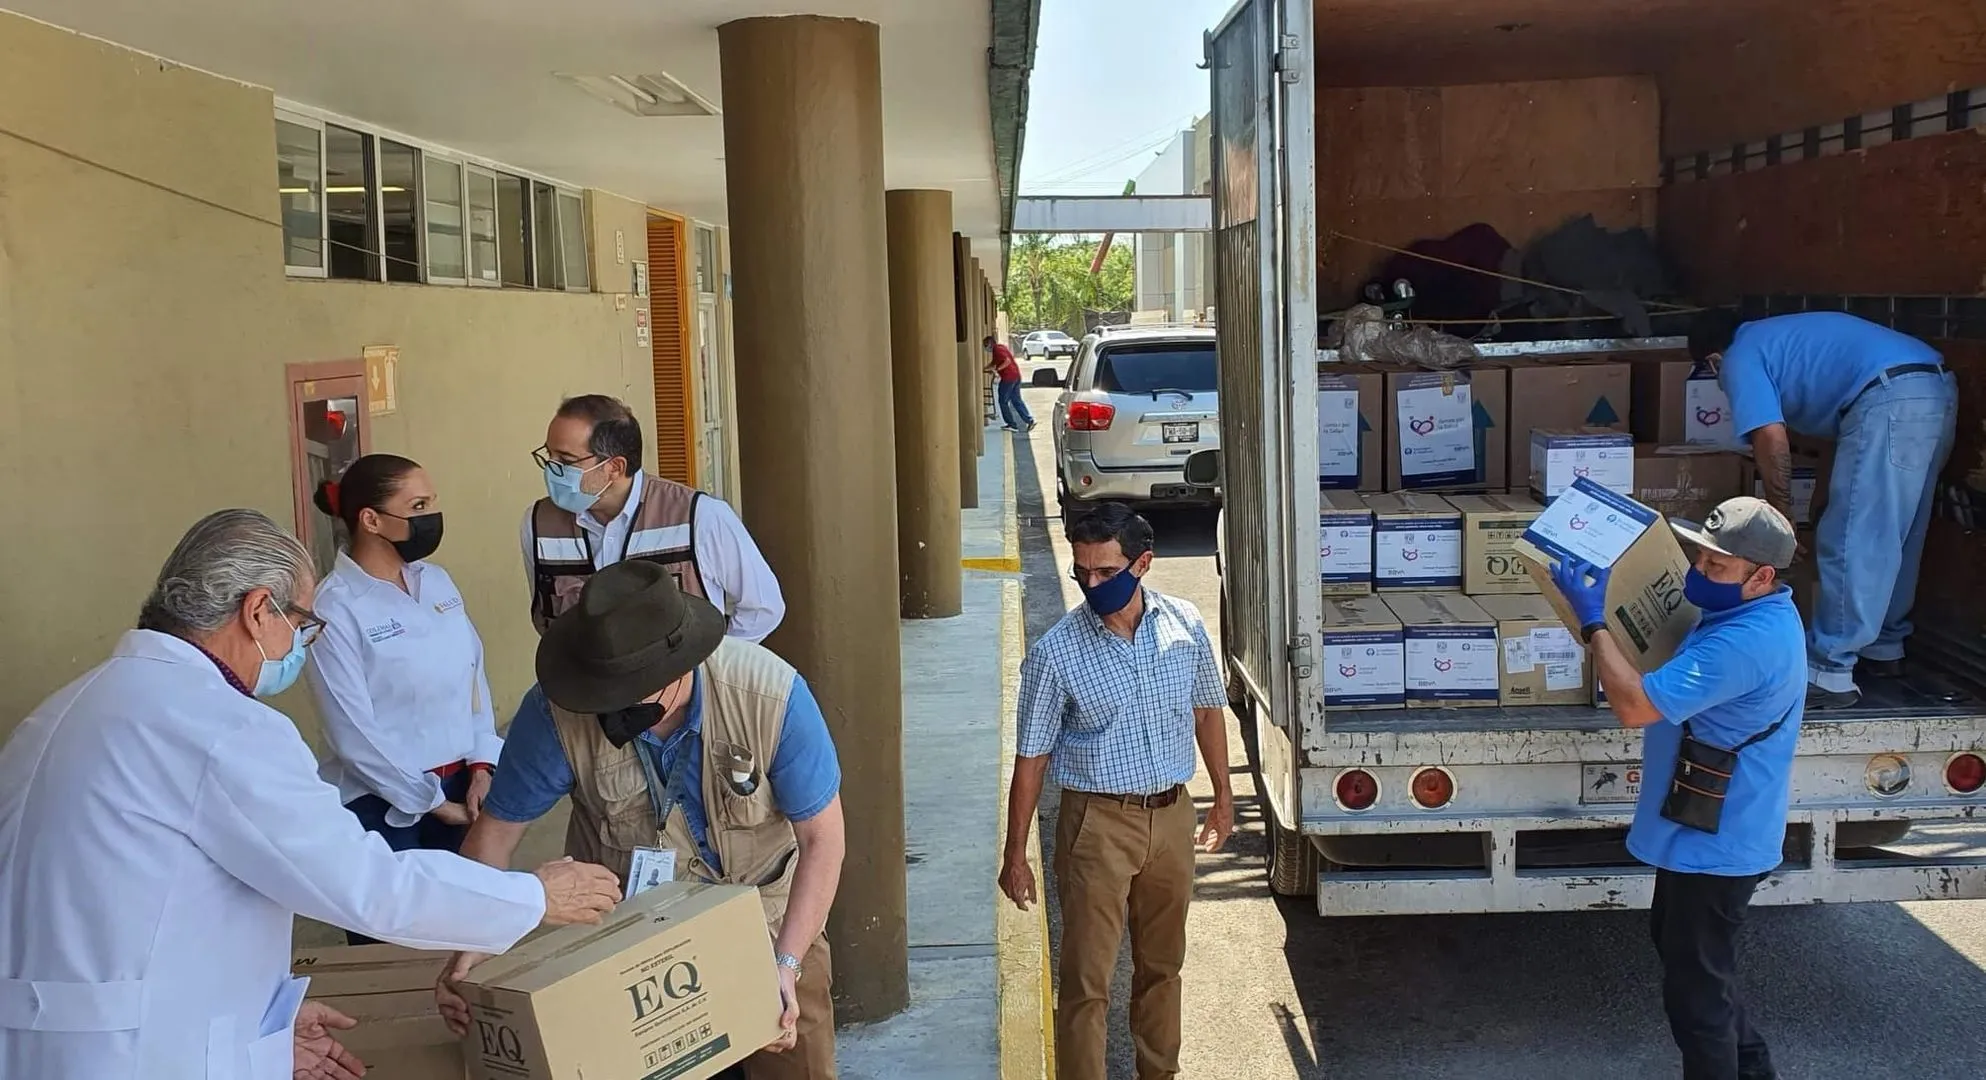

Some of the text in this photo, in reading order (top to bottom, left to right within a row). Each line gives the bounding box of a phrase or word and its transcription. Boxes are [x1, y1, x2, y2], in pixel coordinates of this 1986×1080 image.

[1650, 568, 1682, 616] EQ
[623, 960, 703, 1024] EQ
[475, 1019, 526, 1066] EQ
